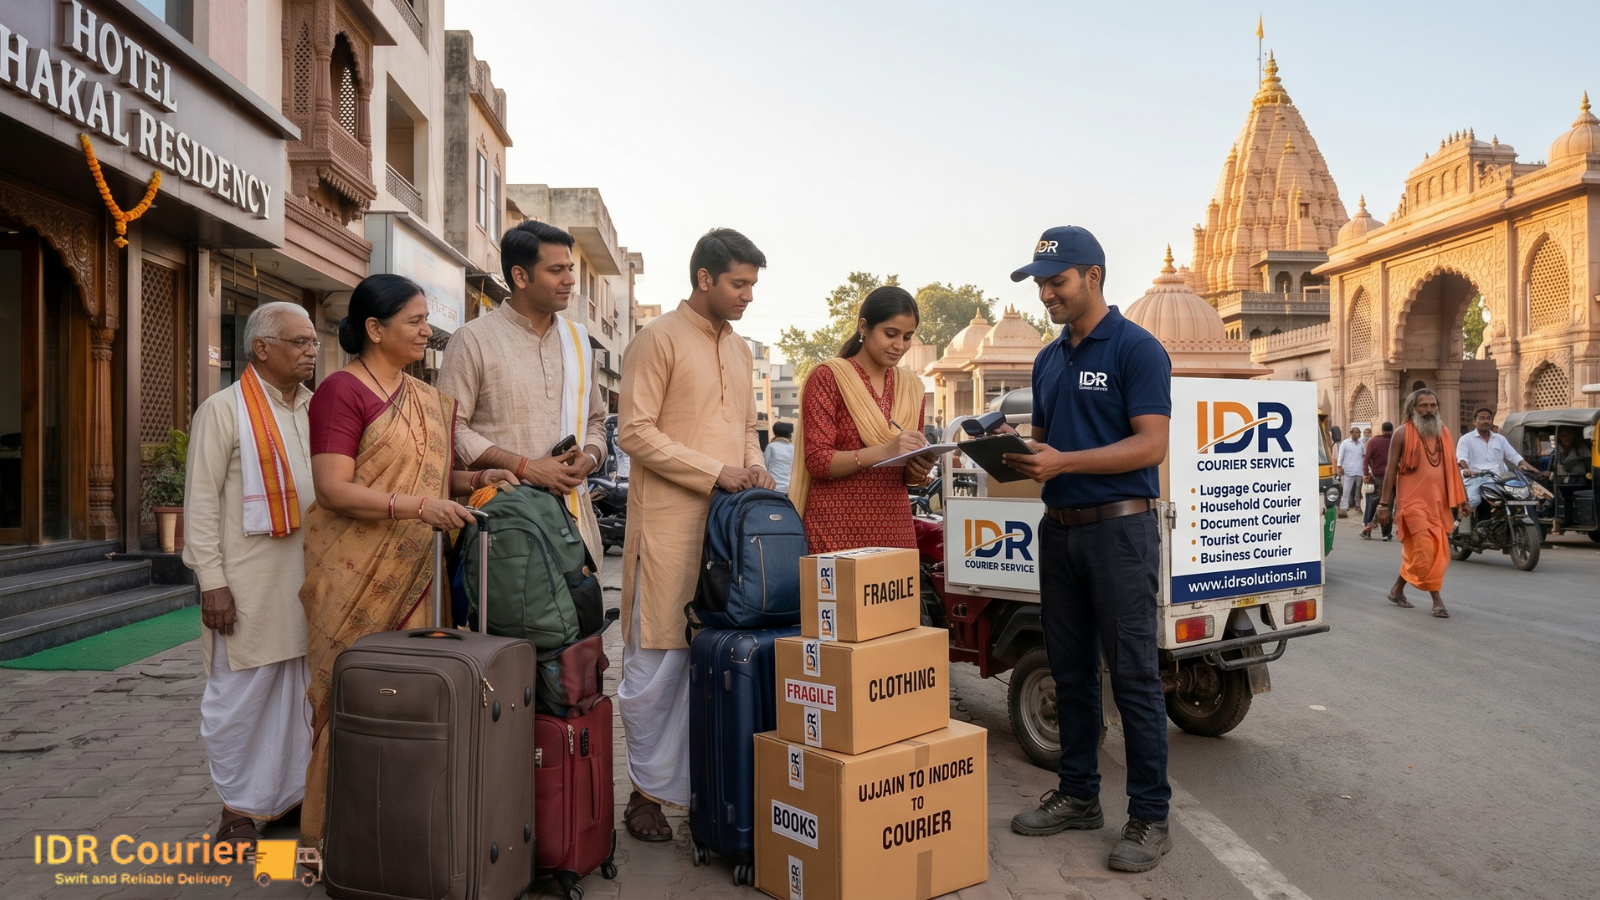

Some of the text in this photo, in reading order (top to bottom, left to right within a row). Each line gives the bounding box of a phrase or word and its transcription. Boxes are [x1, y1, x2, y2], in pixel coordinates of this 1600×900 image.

[71, 0, 178, 113] HOTEL
[0, 23, 272, 220] HAKAL RESIDENCY
[1079, 370, 1108, 387] IDR
[1196, 400, 1294, 454] IDR
[1196, 456, 1296, 472] COURIER SERVICE
[1199, 479, 1292, 498] Luggage Courier
[1199, 495, 1302, 514] Household Courier
[1199, 511, 1301, 531] Document Courier
[964, 518, 1034, 562] IDR
[1199, 528, 1282, 547] Tourist Courier
[964, 559, 1035, 574] COURIER SERVICE
[1199, 544, 1293, 565] Business Courier
[820, 566, 831, 595] IDR
[863, 575, 915, 607] FRAGILE
[1188, 567, 1308, 593] www.idrsolutions.in
[806, 642, 817, 673] IDR
[786, 682, 835, 706] FRAGILE
[868, 666, 936, 703] CLOTHING
[807, 712, 818, 743] IDR
[790, 752, 801, 782] IDR
[858, 756, 974, 803] UJJAIN TO INDORE
[911, 795, 925, 812] TO
[773, 805, 817, 839] BOOKS
[882, 809, 952, 850] COURIER
